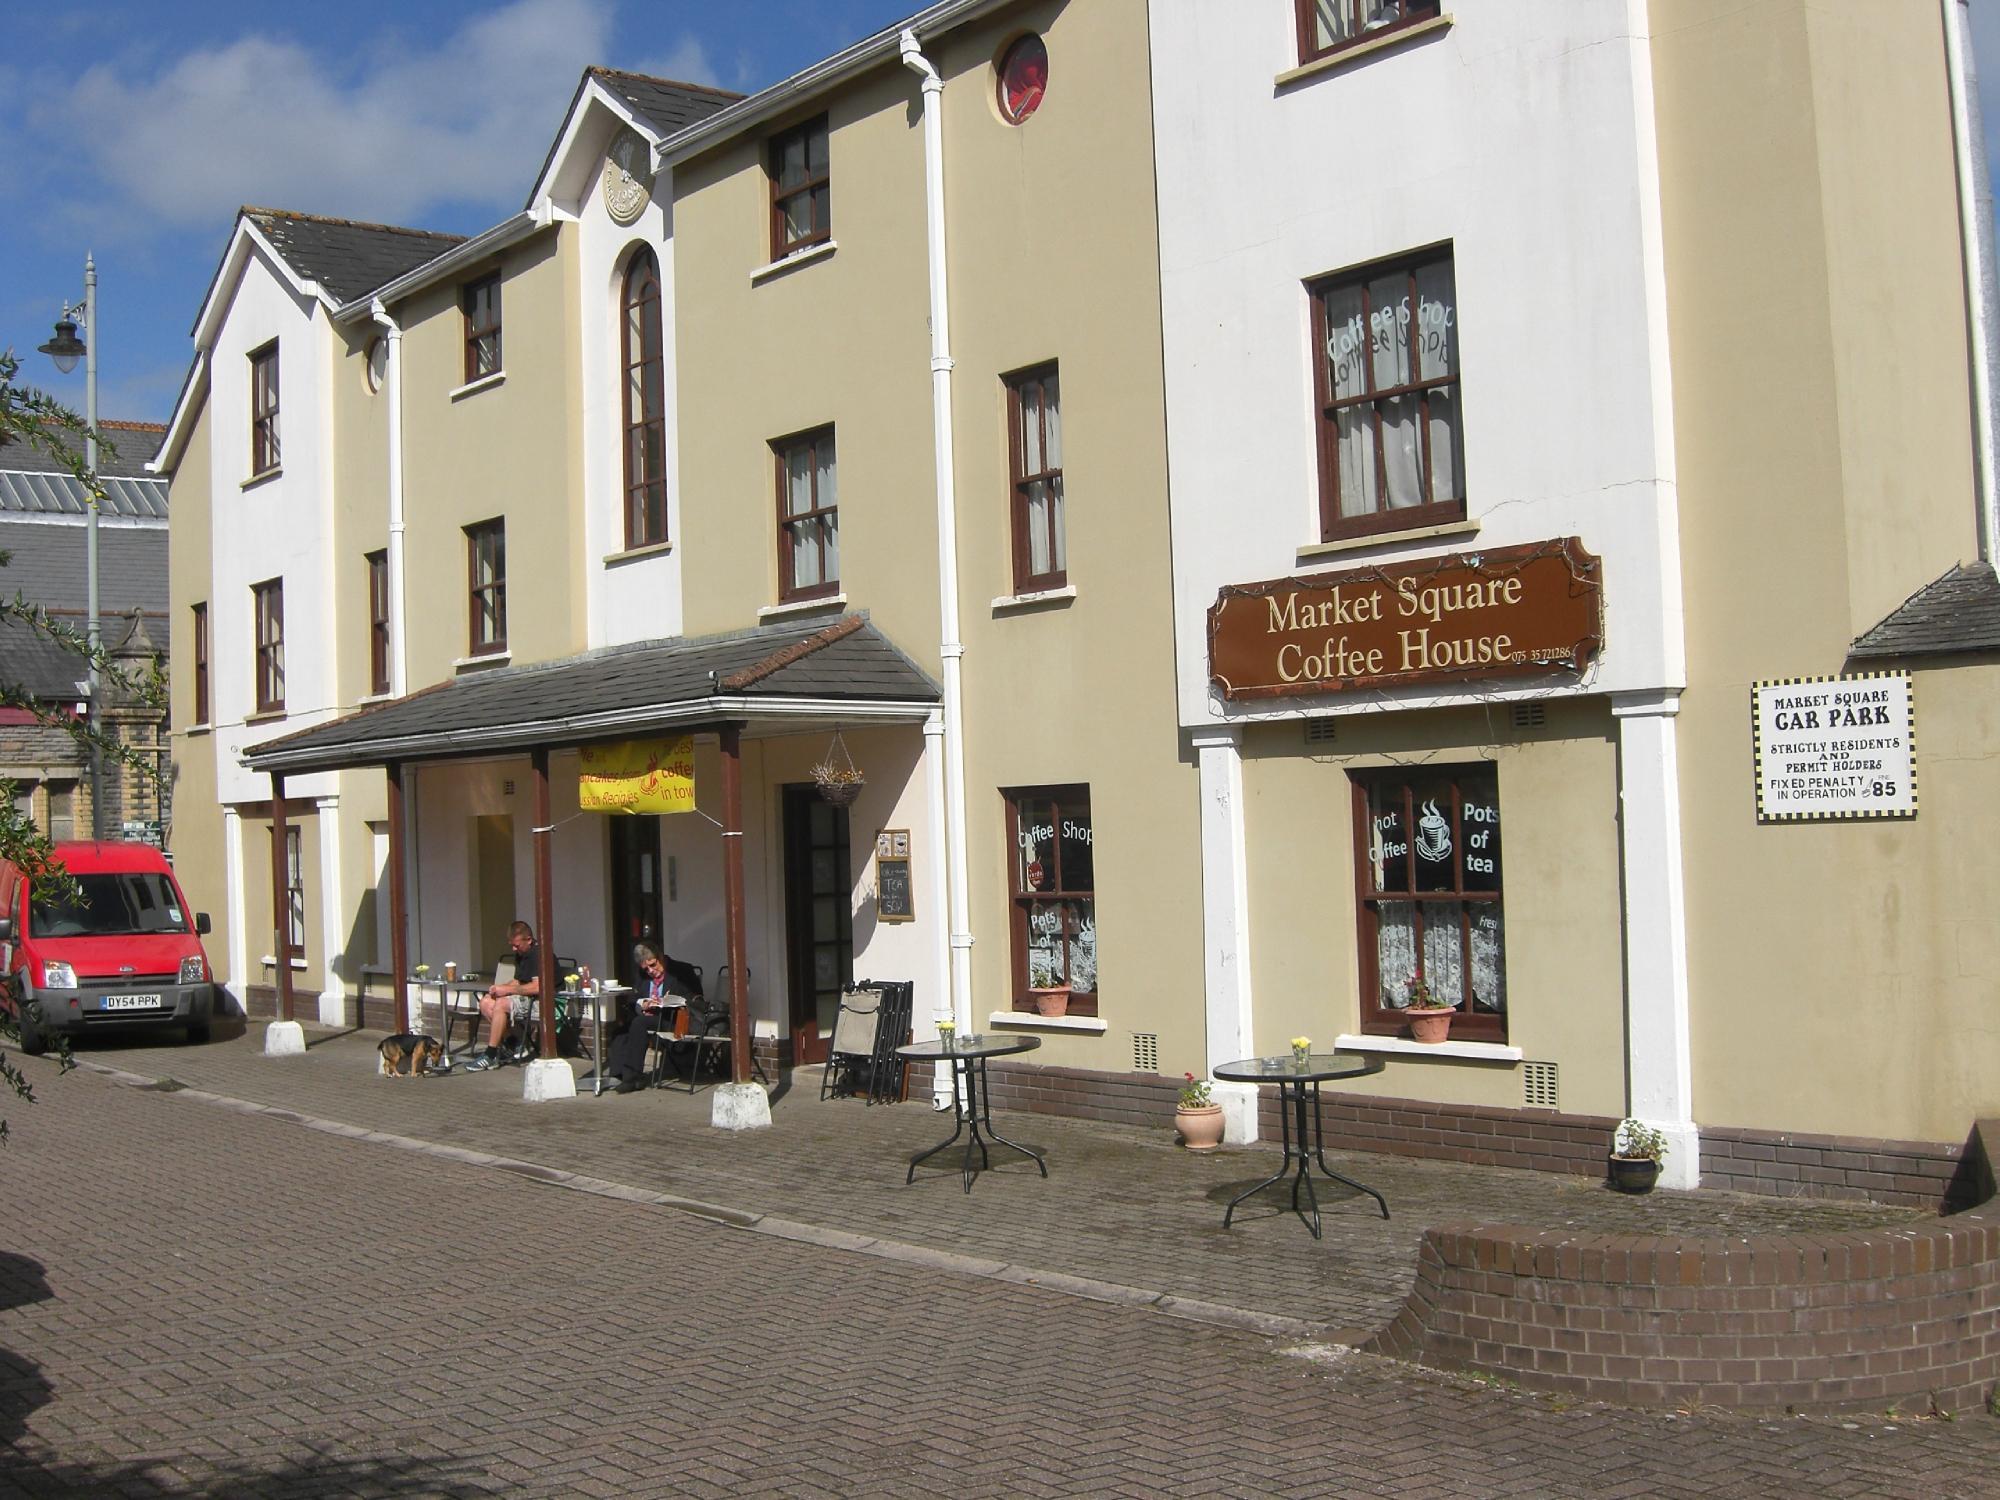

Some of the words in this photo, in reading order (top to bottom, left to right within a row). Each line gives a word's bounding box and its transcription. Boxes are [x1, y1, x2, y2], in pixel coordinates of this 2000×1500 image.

[1266, 586, 1383, 633] Market
[1397, 576, 1522, 622] Square
[1276, 637, 1383, 682] Coffee
[1397, 628, 1512, 671] House
[1774, 694, 1829, 710] MARKET
[1834, 690, 1889, 706] SQUARE
[1775, 710, 1820, 730] CAR
[1829, 705, 1890, 727] PARK
[1771, 742, 1827, 754] STRICTLY
[1831, 738, 1900, 751] RESIDENTS
[1819, 752, 1850, 760] AND
[1786, 762, 1828, 773] PERMIT
[1833, 760, 1882, 772] HOLDERS
[1771, 779, 1805, 789] FIXED
[1808, 775, 1864, 788] PENALTY
[1777, 790, 1788, 800] IN
[1792, 788, 1856, 800] OPERATION
[1872, 781, 1896, 797] 85
[661, 786, 671, 800] in
[1464, 803, 1499, 823] Pots
[1470, 829, 1489, 849] of
[1466, 853, 1493, 873] tea
[108, 997, 135, 1008] DY54
[138, 995, 158, 1006] PPK
